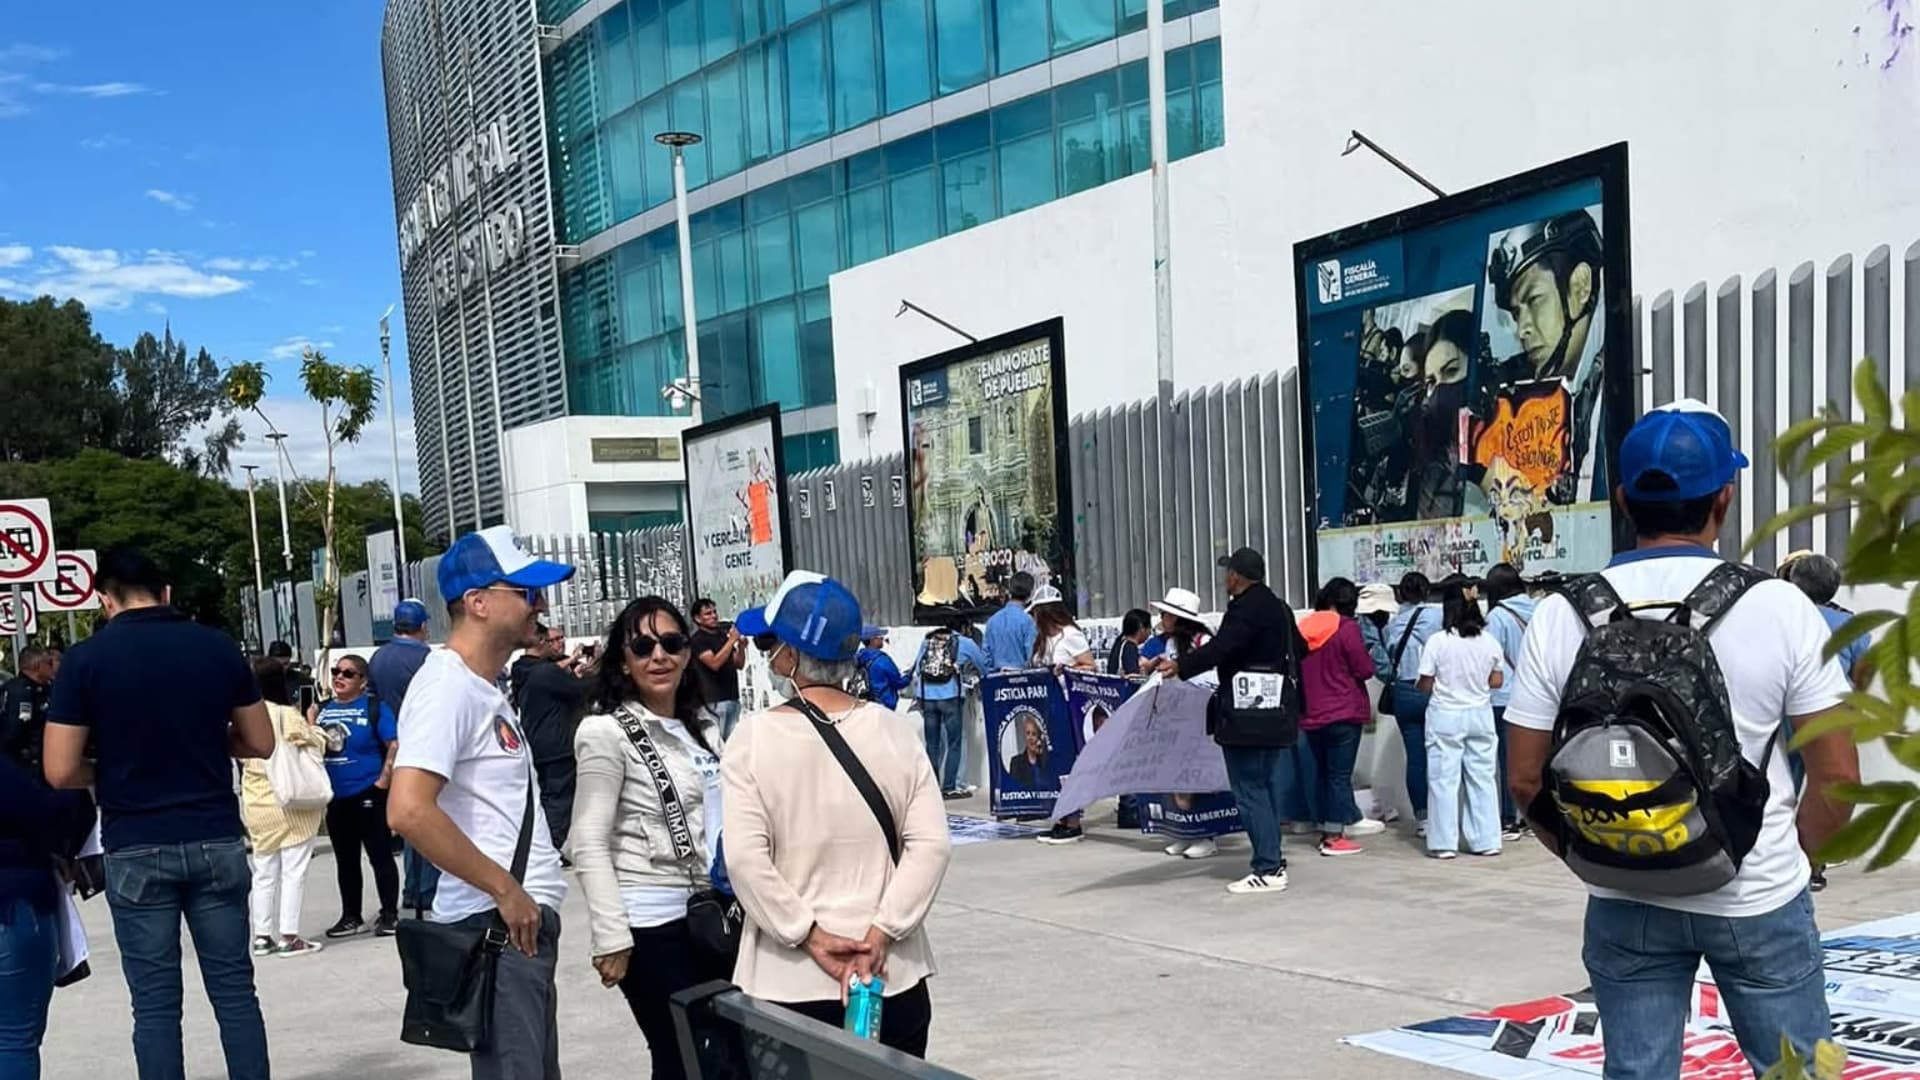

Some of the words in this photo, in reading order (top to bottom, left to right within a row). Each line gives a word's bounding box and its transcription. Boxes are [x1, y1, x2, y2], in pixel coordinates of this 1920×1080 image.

[984, 380, 999, 399] DE
[724, 550, 752, 569] GENTE
[665, 801, 693, 859] BIMBA
